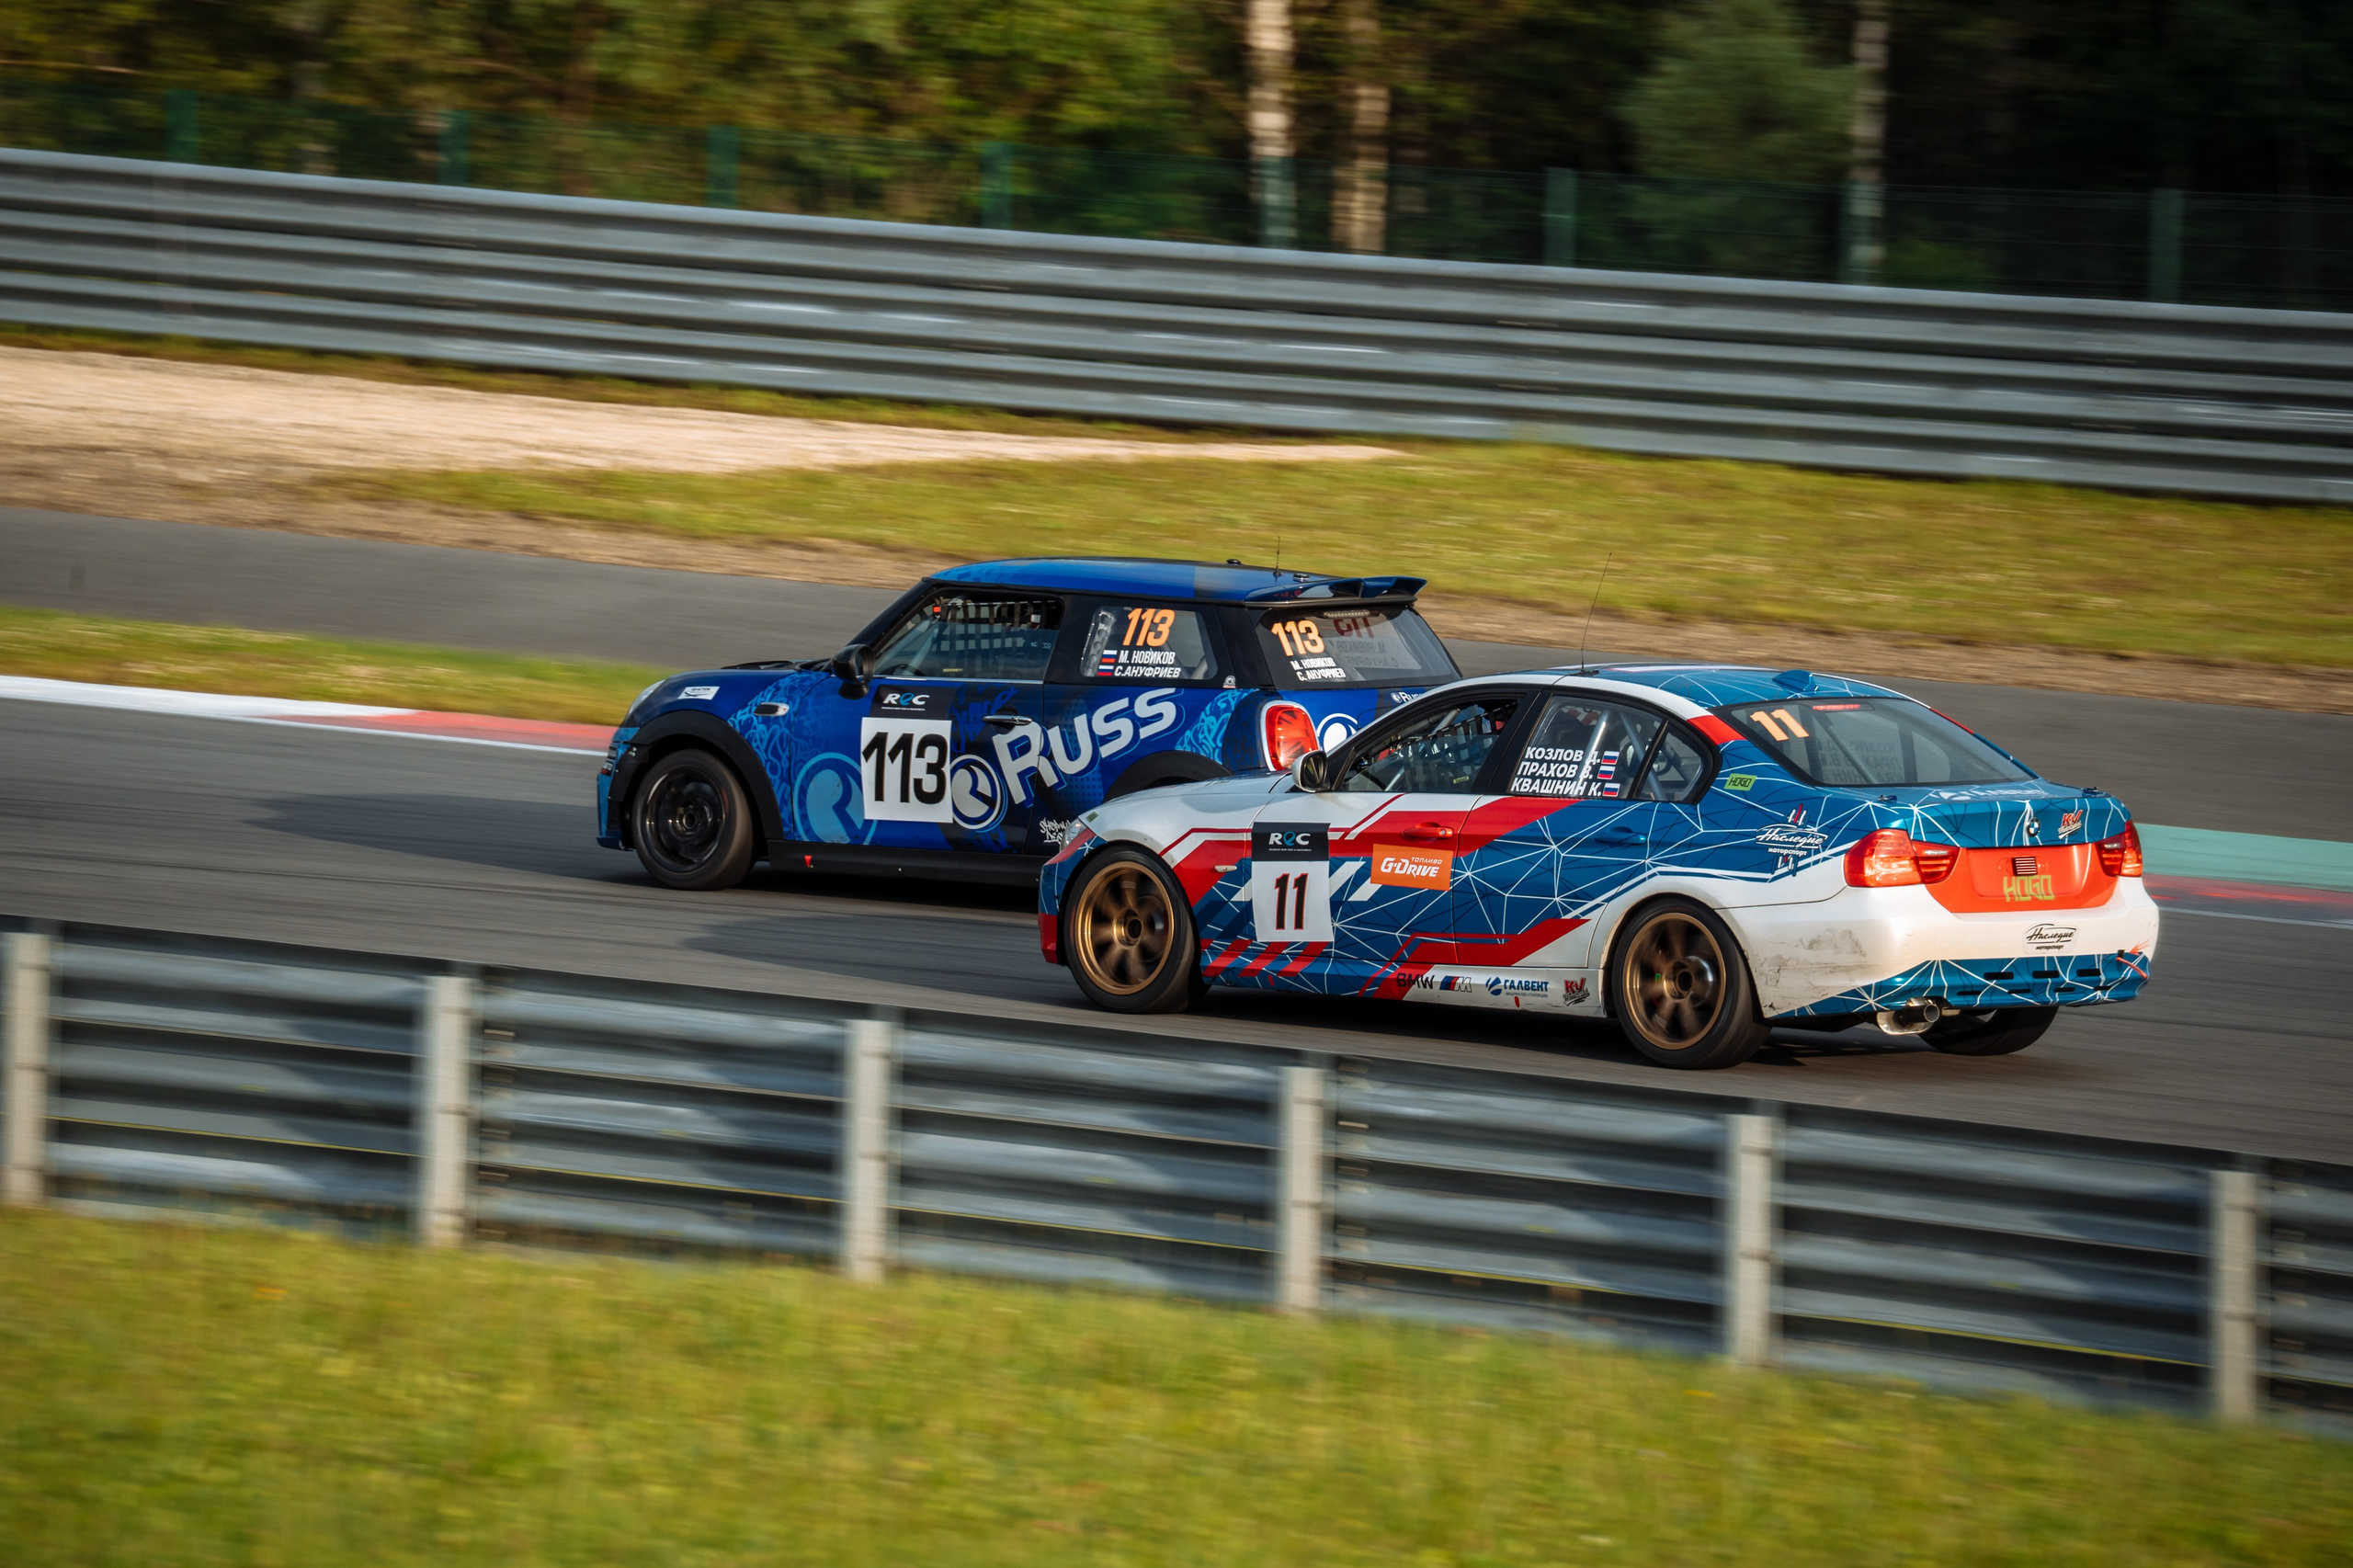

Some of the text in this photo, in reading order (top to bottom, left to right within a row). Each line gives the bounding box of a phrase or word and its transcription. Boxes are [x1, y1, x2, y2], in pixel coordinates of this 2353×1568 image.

[1122, 608, 1176, 647] 113
[1271, 619, 1325, 656] 113
[1118, 650, 1176, 665] М. НОВИКОВ
[1290, 656, 1336, 671] М. НОВИКОВ
[1296, 667, 1347, 682] С. АНУФРИЕВ
[1749, 709, 1810, 742] 11
[1524, 746, 1601, 766] КОЗЛОВ Д.
[862, 732, 949, 805] 113
[1517, 761, 1594, 779] ПРАХОВ В.
[1510, 777, 1602, 797] КВАШНИН К.
[1728, 777, 1753, 788] HOGO
[1756, 827, 1824, 848] Наследие
[1768, 847, 1808, 857] моторспорт
[2003, 875, 2055, 903] HOGO
[1274, 872, 1309, 930] 11
[2026, 926, 2074, 943] Наследие
[1397, 972, 1435, 989] BMW
[1504, 979, 1549, 992] ГАЛВЕНТ
